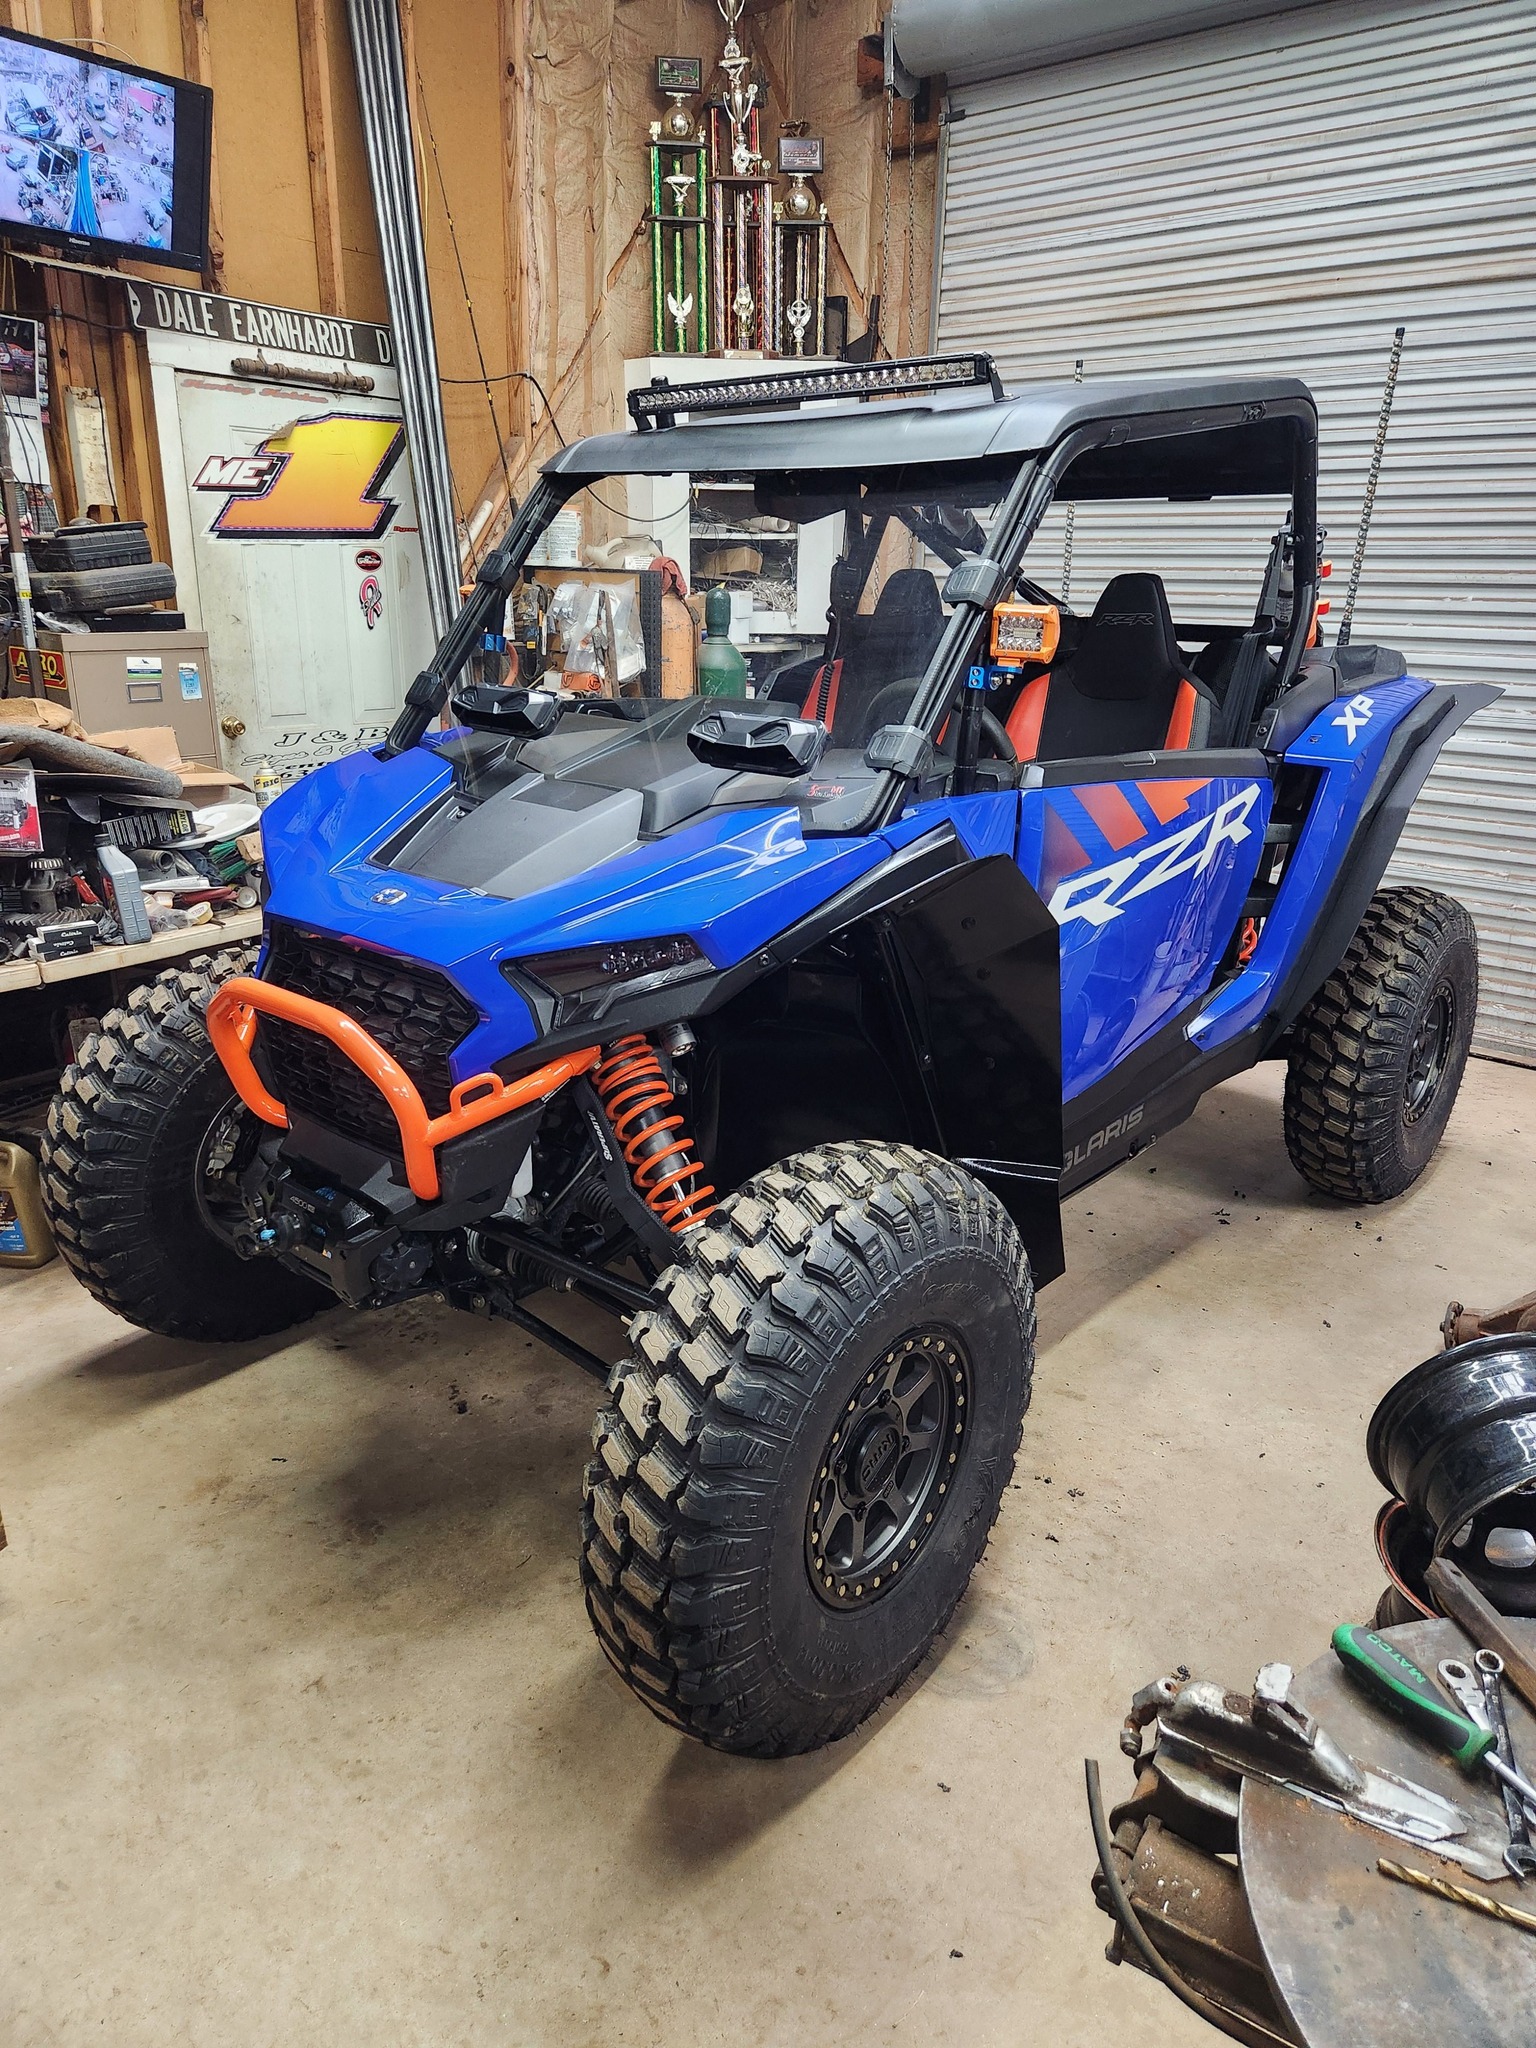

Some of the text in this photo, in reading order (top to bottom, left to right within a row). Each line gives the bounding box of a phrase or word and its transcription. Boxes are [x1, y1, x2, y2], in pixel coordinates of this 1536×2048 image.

[152, 287, 395, 364] DALE EARNHARDT D
[1096, 613, 1154, 626] RZR
[311, 730, 348, 744] &
[354, 727, 390, 741] B
[1331, 694, 1374, 746] XP
[1048, 783, 1261, 927] RZR
[1061, 1103, 1144, 1174] OLARIS
[1367, 1633, 1427, 1684] MATCO
